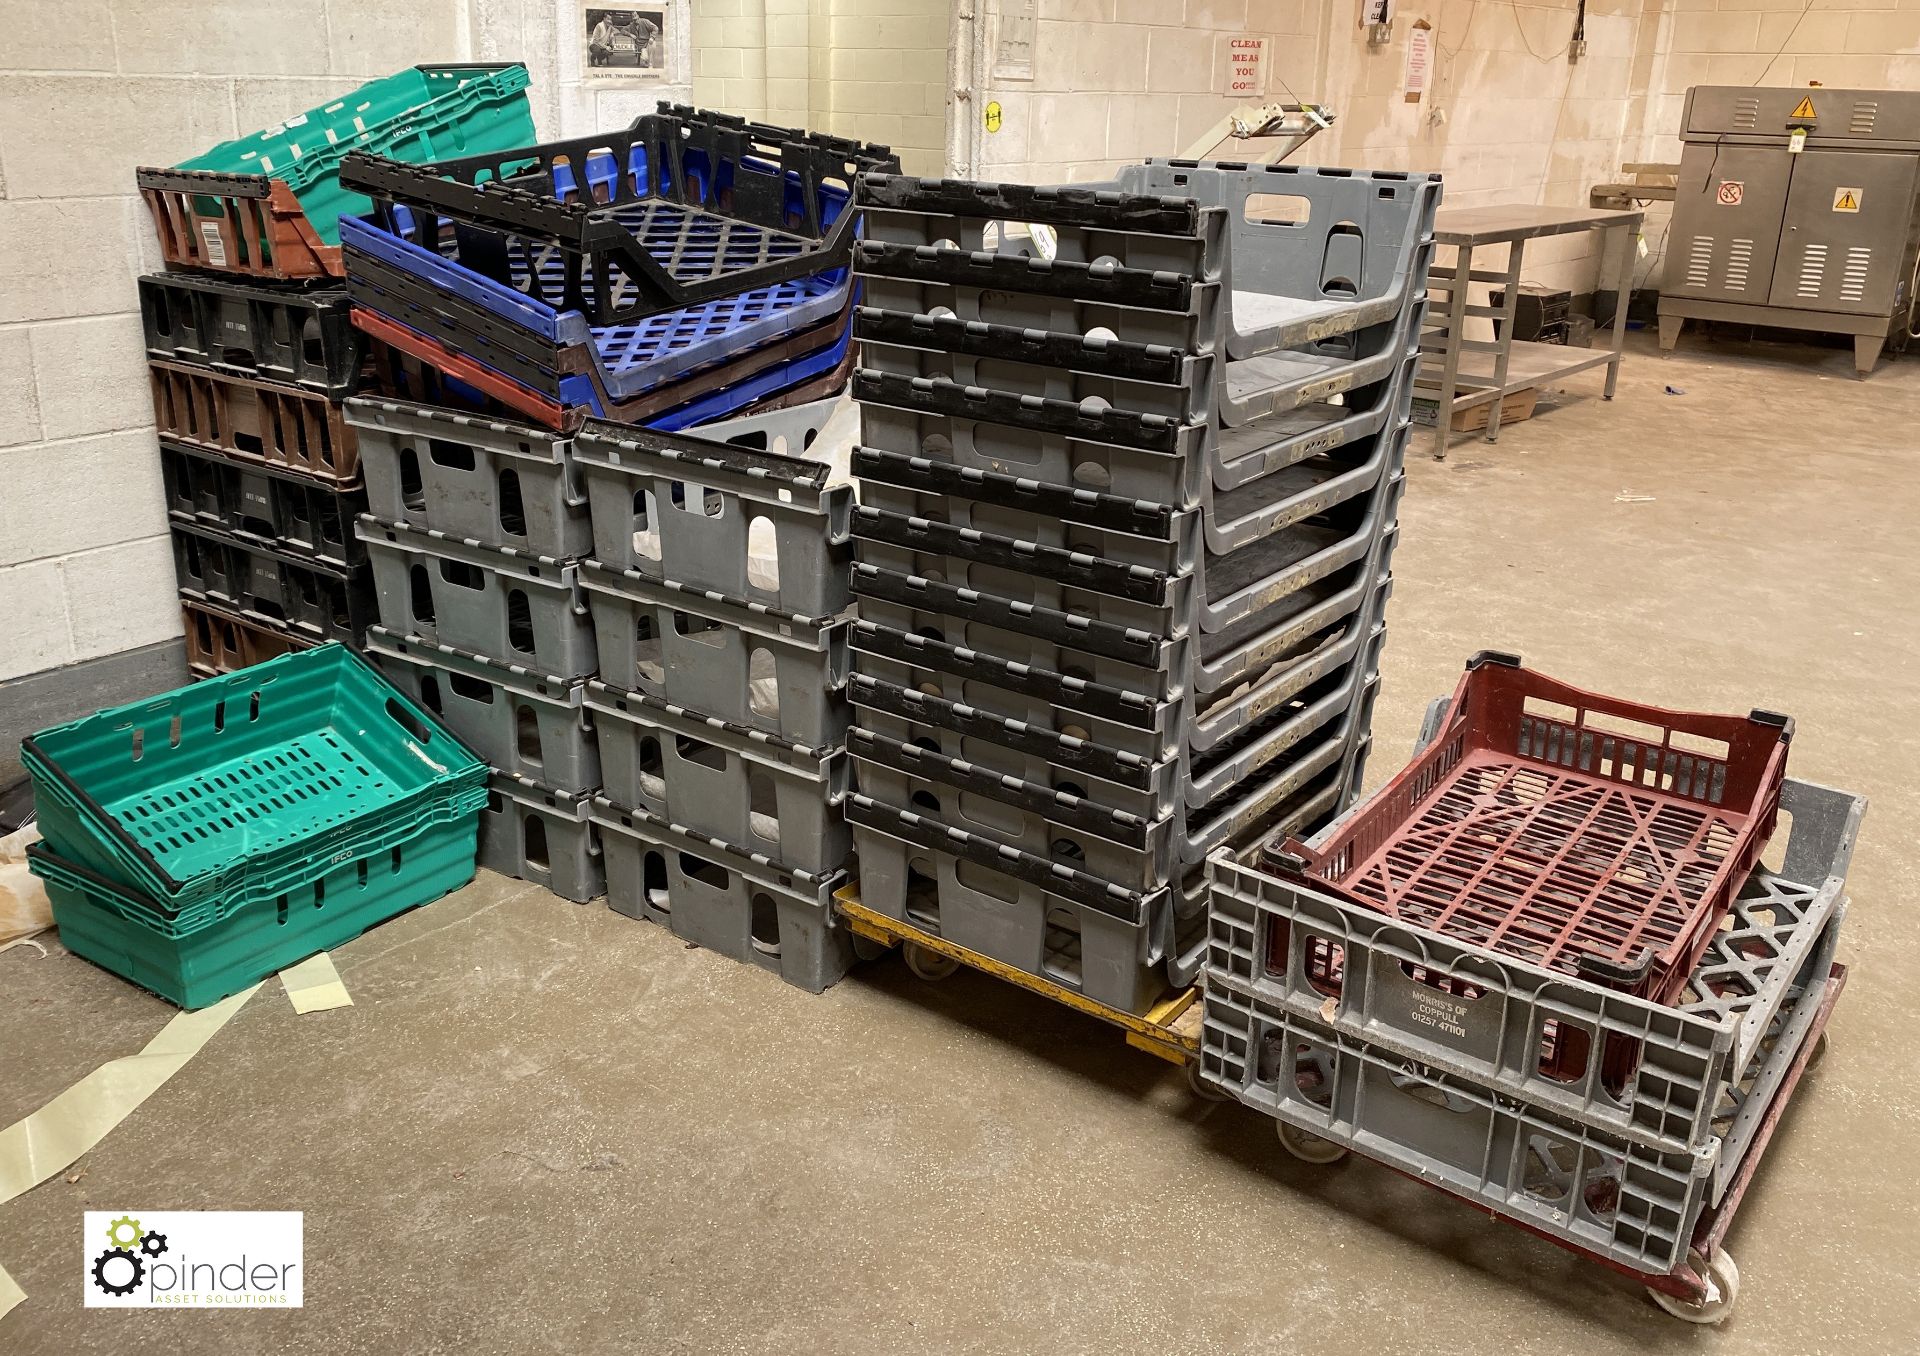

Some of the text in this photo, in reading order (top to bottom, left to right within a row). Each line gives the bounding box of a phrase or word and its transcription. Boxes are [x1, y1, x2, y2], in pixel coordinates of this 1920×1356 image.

[1231, 40, 1262, 48] CLEAN
[1236, 68, 1254, 76] YOU
[1232, 82, 1246, 90] GO
[331, 850, 353, 864] IFCO
[1412, 990, 1468, 1017] MORRIS'S OF
[1411, 1011, 1437, 1027] 01257
[1419, 1004, 1459, 1025] COPPULL
